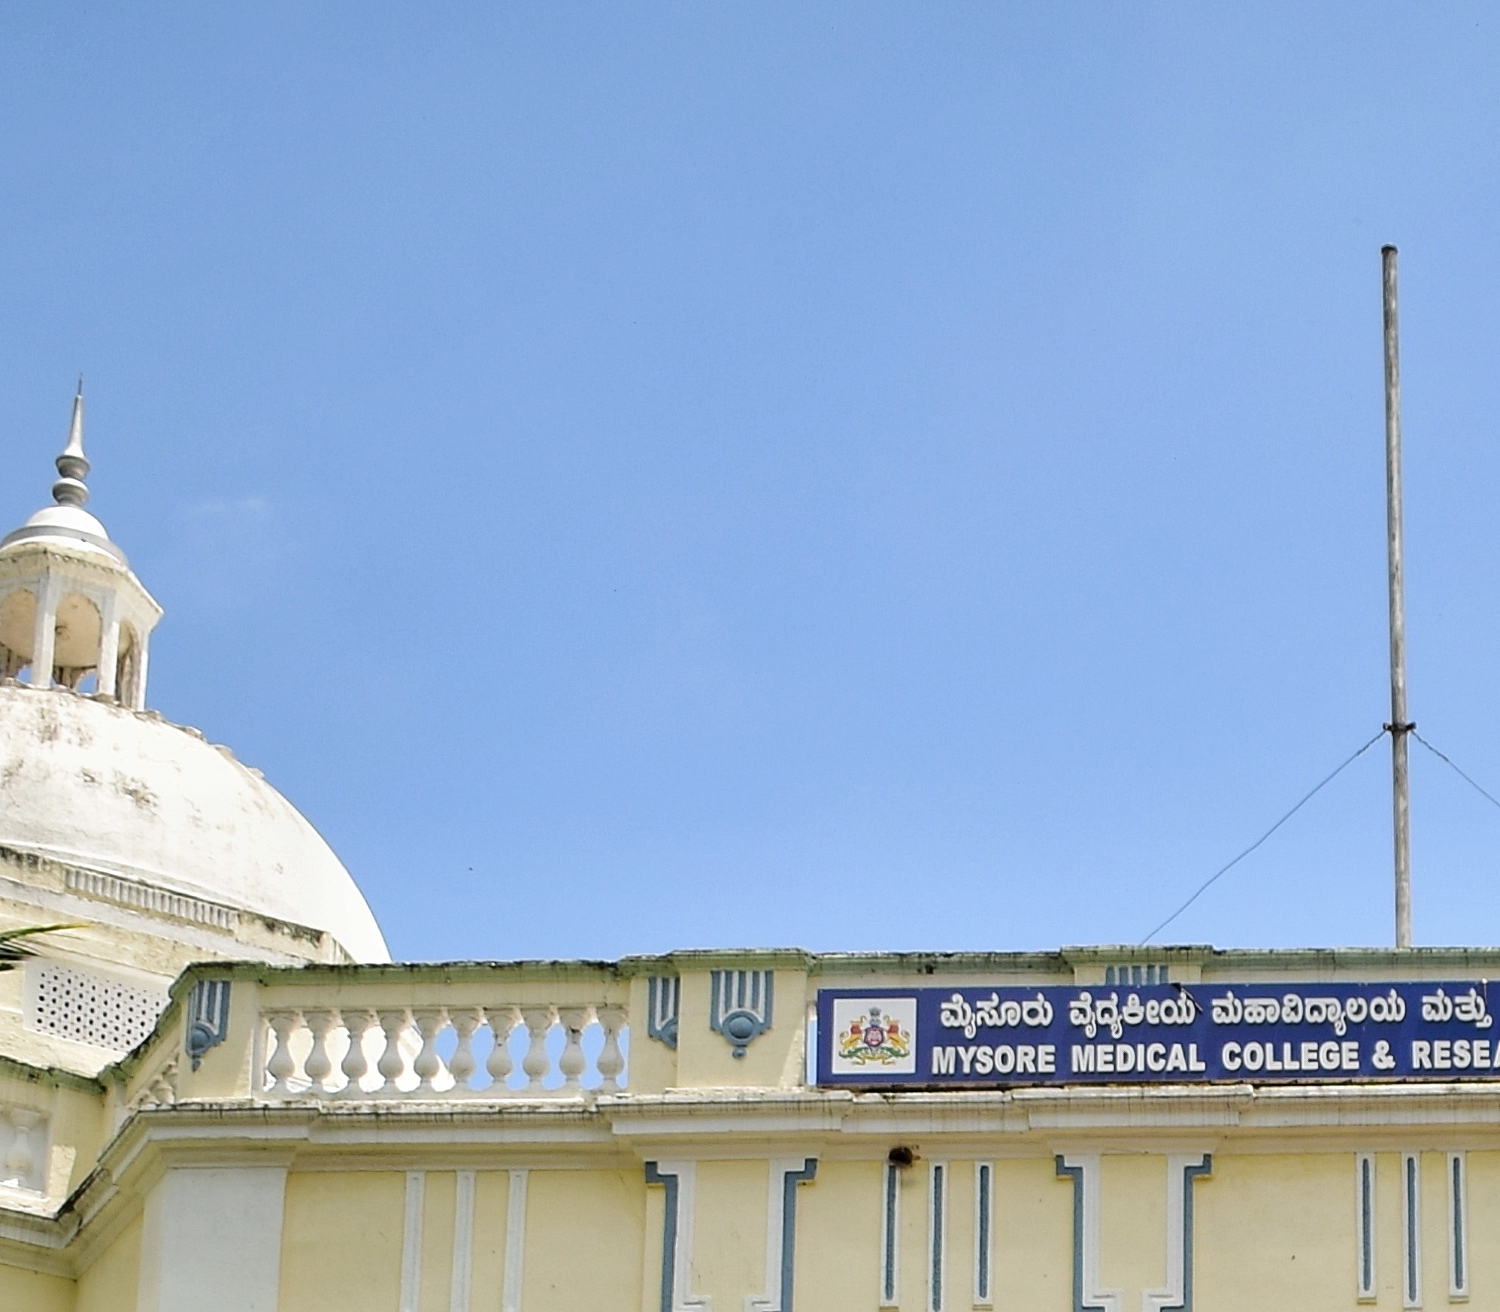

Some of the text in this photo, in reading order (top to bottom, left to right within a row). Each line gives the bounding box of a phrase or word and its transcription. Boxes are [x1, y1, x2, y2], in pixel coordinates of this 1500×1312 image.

[940, 993, 1053, 1039] ಮೈಸೂರು
[1070, 991, 1197, 1039] ವೈದ್ಯಕೀಯ
[1211, 989, 1406, 1037] ಮಹಾವಿದ್ಯಾಲಯ
[1422, 988, 1491, 1027] ಮತ್ತು
[931, 1044, 1056, 1076] MYSORE
[1071, 1043, 1206, 1073] MEDICAL
[1221, 1041, 1360, 1072] COLLEGE
[1372, 1041, 1396, 1070] &
